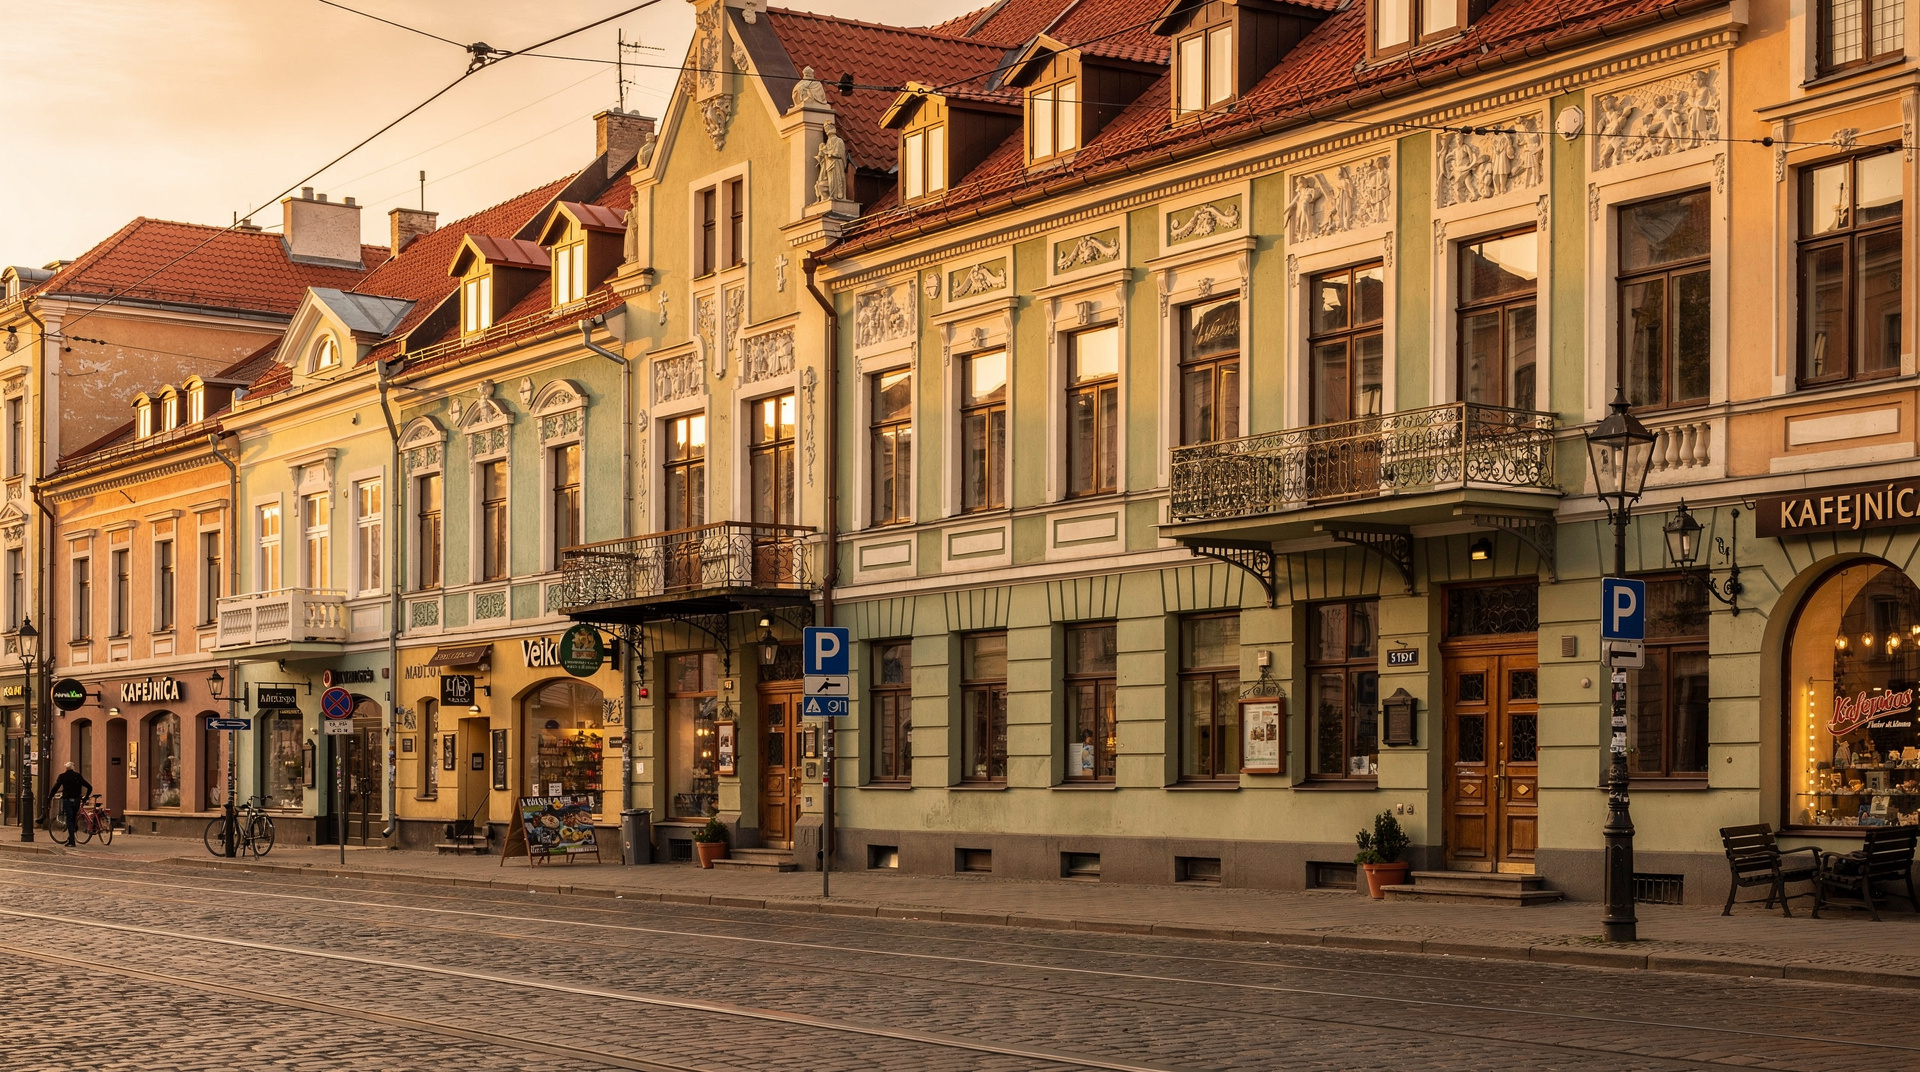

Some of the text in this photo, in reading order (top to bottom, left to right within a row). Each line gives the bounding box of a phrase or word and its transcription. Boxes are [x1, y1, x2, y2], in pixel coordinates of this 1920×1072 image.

[1781, 483, 1920, 530] KAFEJNÍC
[1613, 585, 1637, 633] P
[815, 632, 840, 670] P
